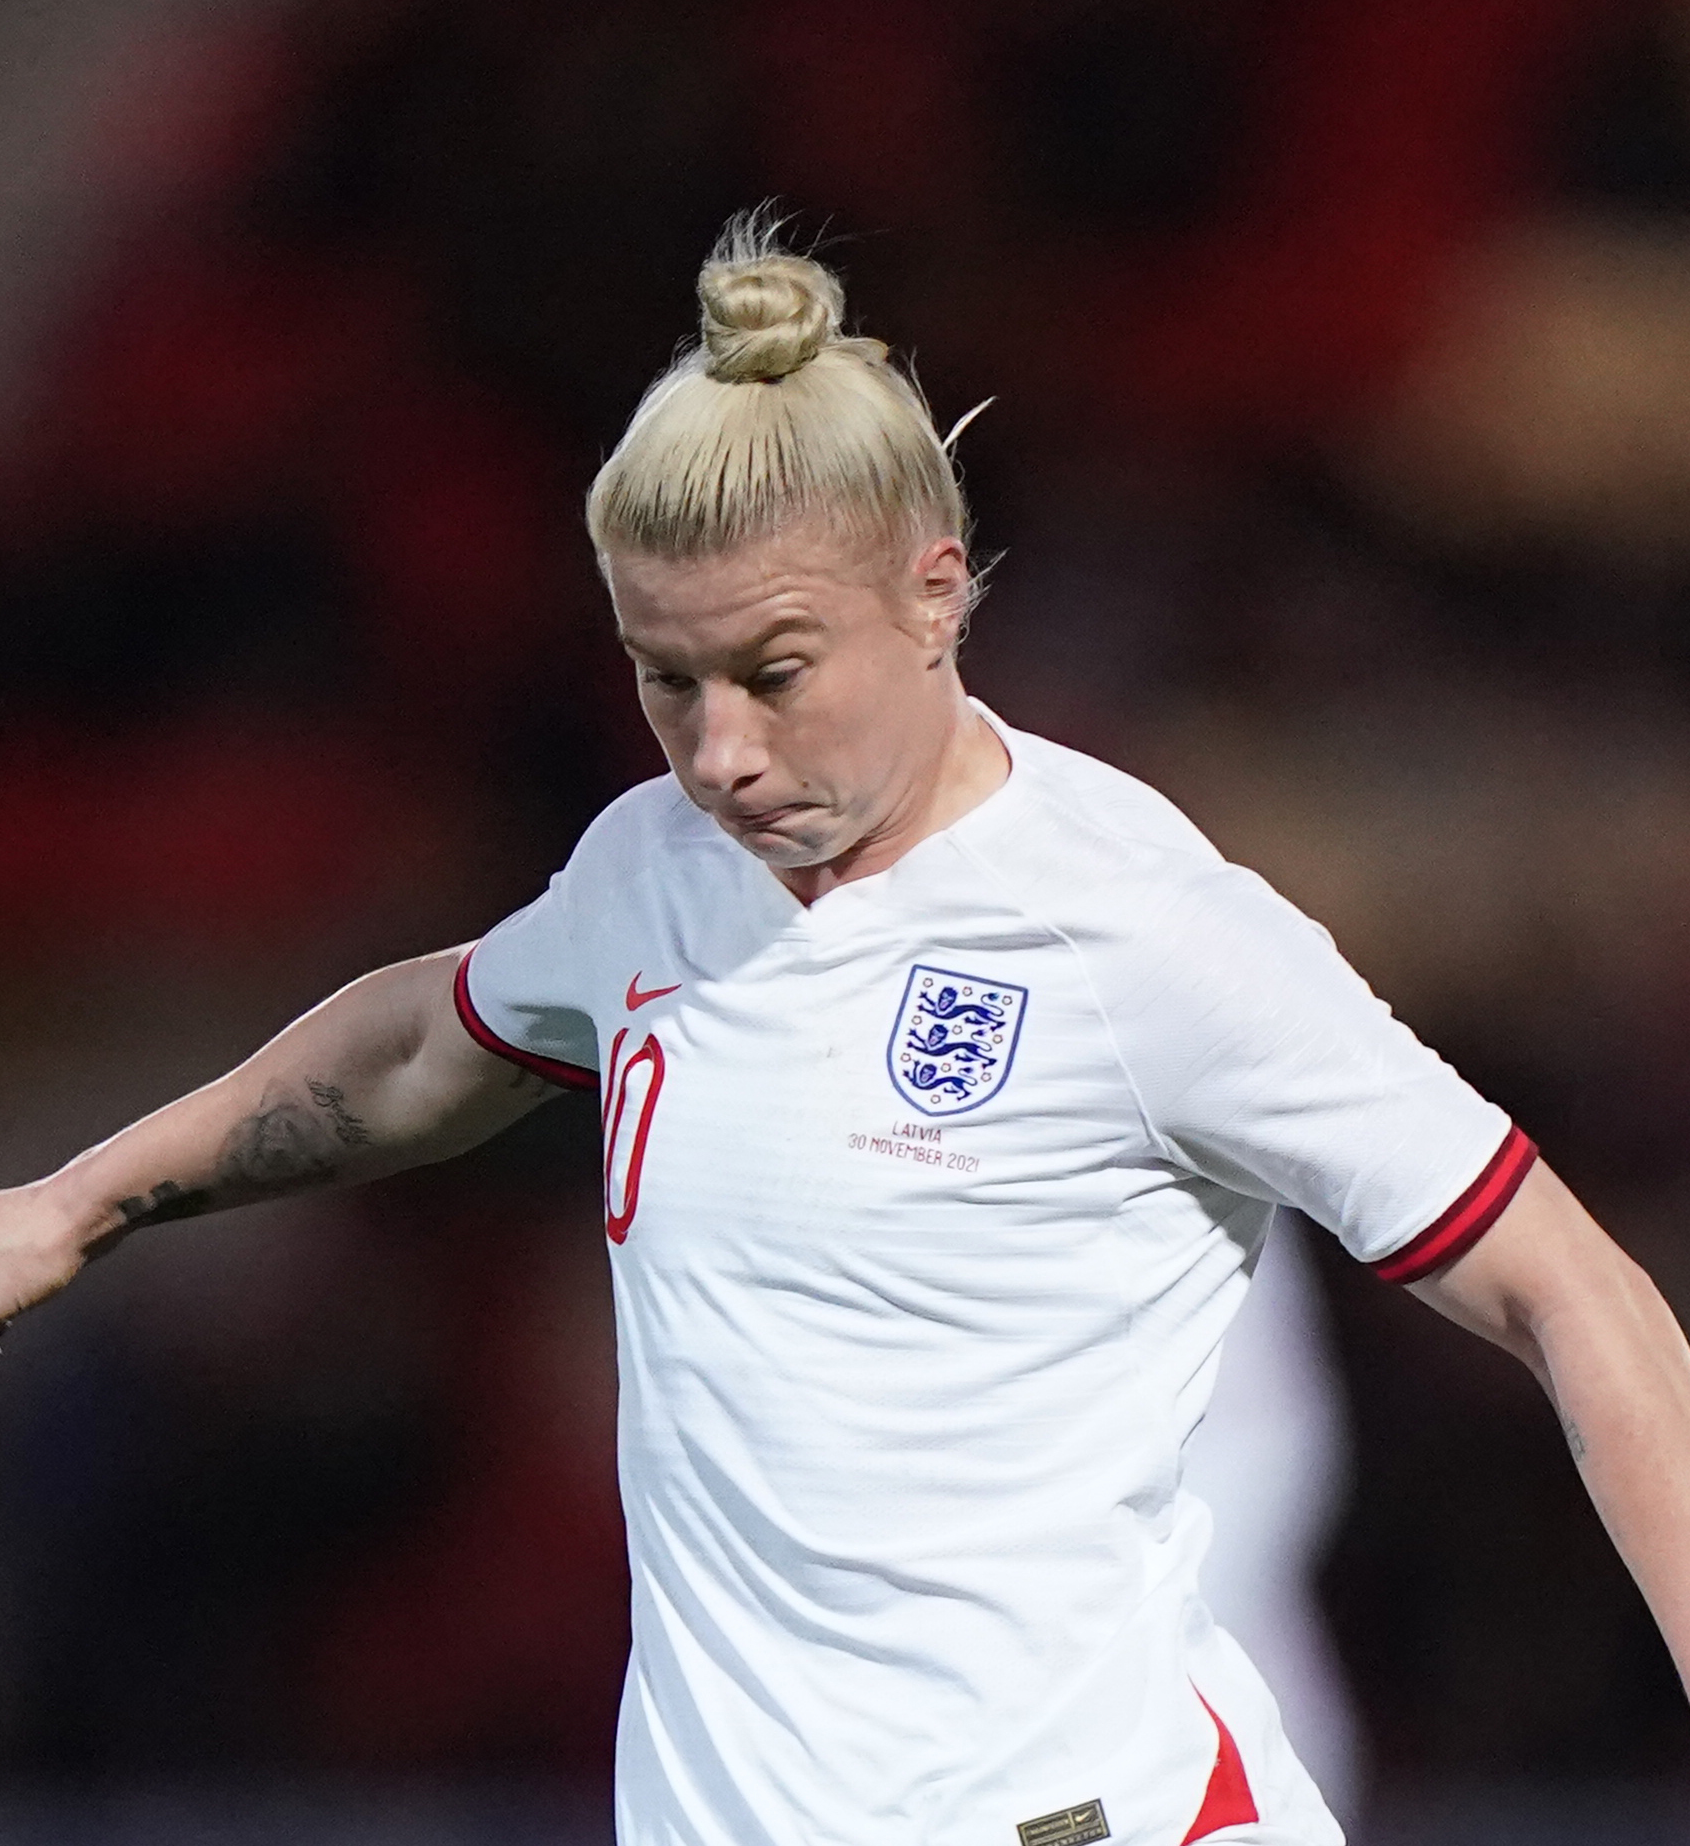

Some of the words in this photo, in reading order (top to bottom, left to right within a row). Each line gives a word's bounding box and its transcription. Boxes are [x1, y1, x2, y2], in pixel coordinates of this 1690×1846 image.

[892, 1120, 942, 1145] LATVIA
[848, 1132, 867, 1150] 30
[870, 1137, 944, 1167] NOVEMBER
[946, 1152, 981, 1174] 2021
